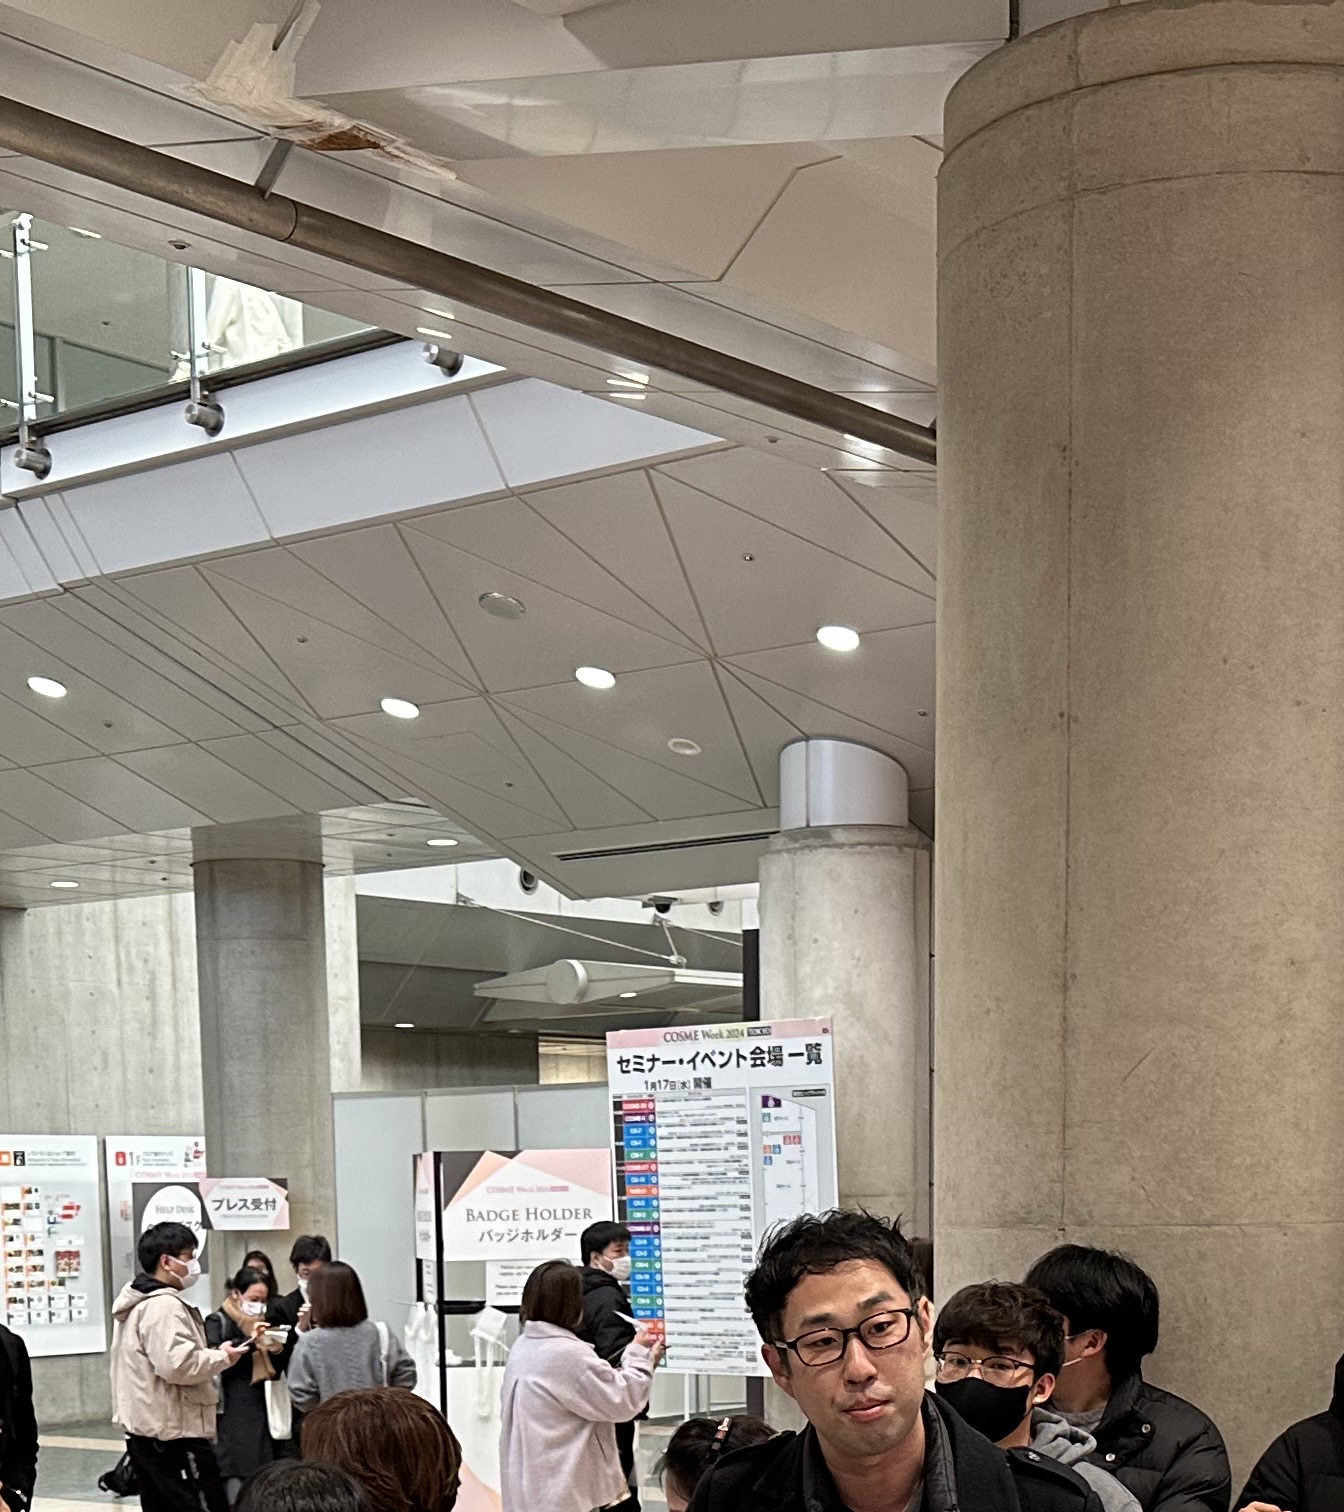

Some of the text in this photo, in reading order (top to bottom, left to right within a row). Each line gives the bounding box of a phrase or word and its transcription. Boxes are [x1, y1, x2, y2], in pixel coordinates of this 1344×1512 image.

[663, 1031, 699, 1043] COSME
[701, 1030, 725, 1041] Week
[726, 1029, 745, 1040] 2024
[617, 1043, 823, 1075] セミナー・イベント会場 一覧
[211, 1197, 277, 1212] プレス受付
[466, 1207, 594, 1223] BADGE HOLDER
[478, 1228, 578, 1244] バッジホルダー
